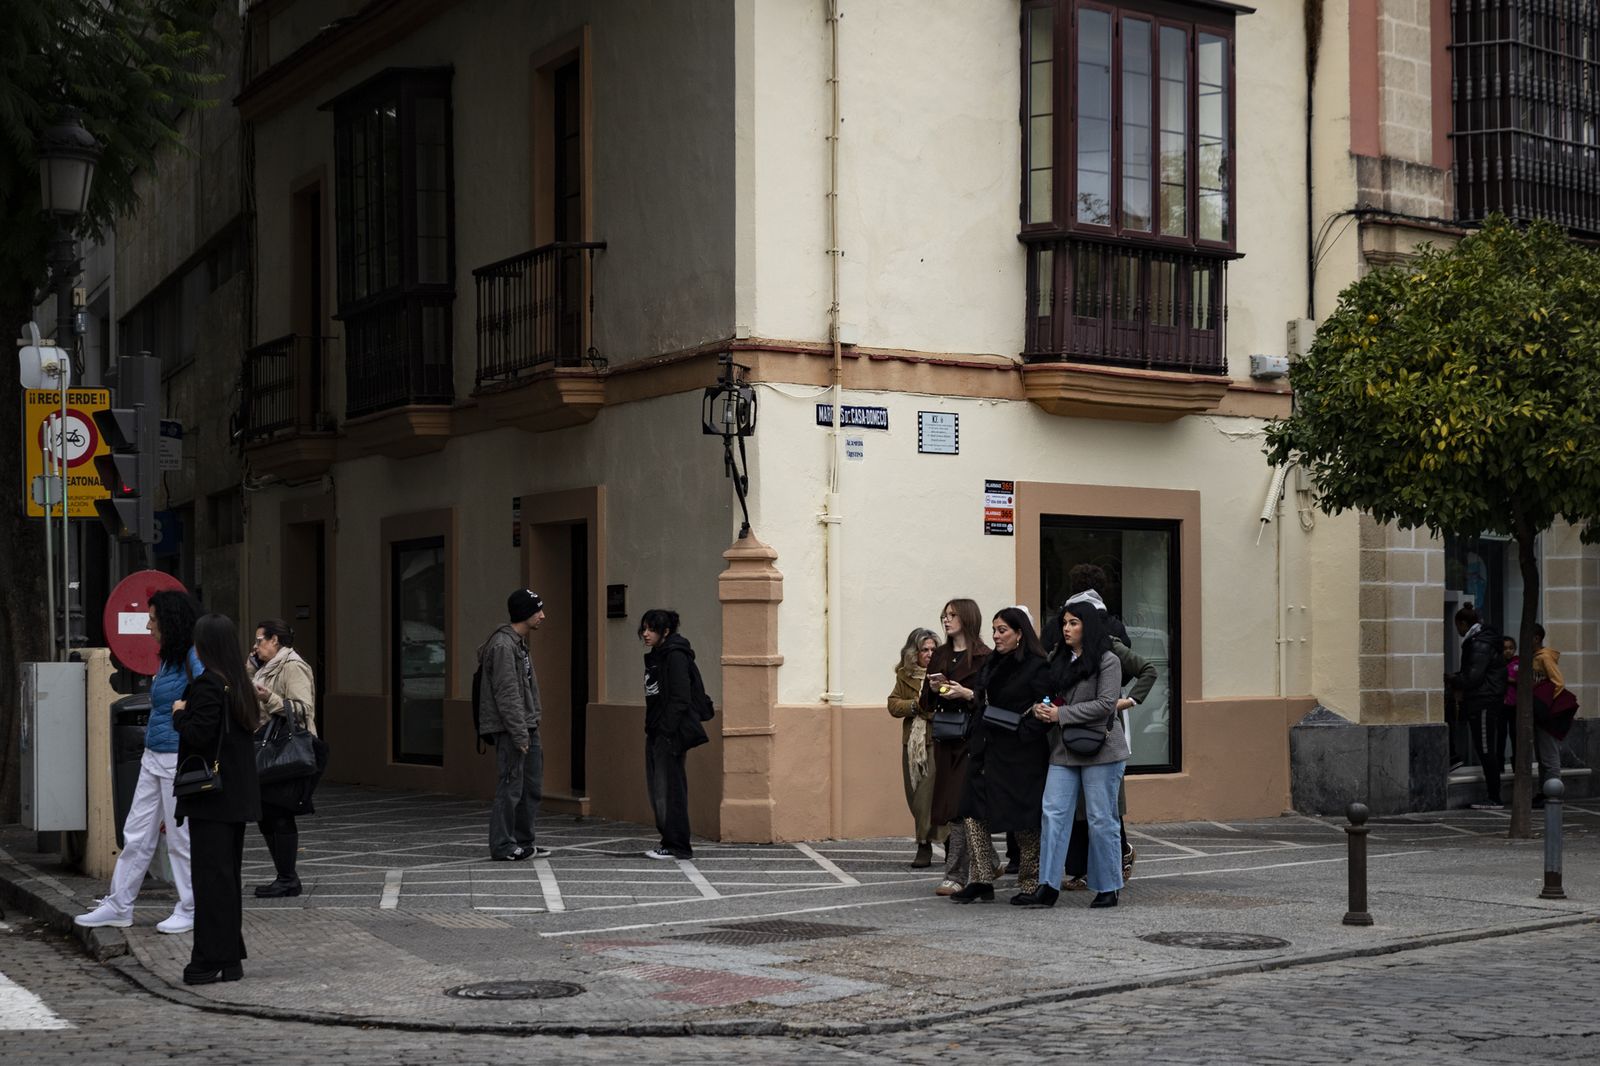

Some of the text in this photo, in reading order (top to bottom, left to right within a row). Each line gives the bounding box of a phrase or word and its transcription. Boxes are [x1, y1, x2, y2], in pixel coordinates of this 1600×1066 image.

[38, 392, 97, 405] RECERDE
[818, 406, 844, 423] MARS
[66, 476, 105, 486] EATONA
